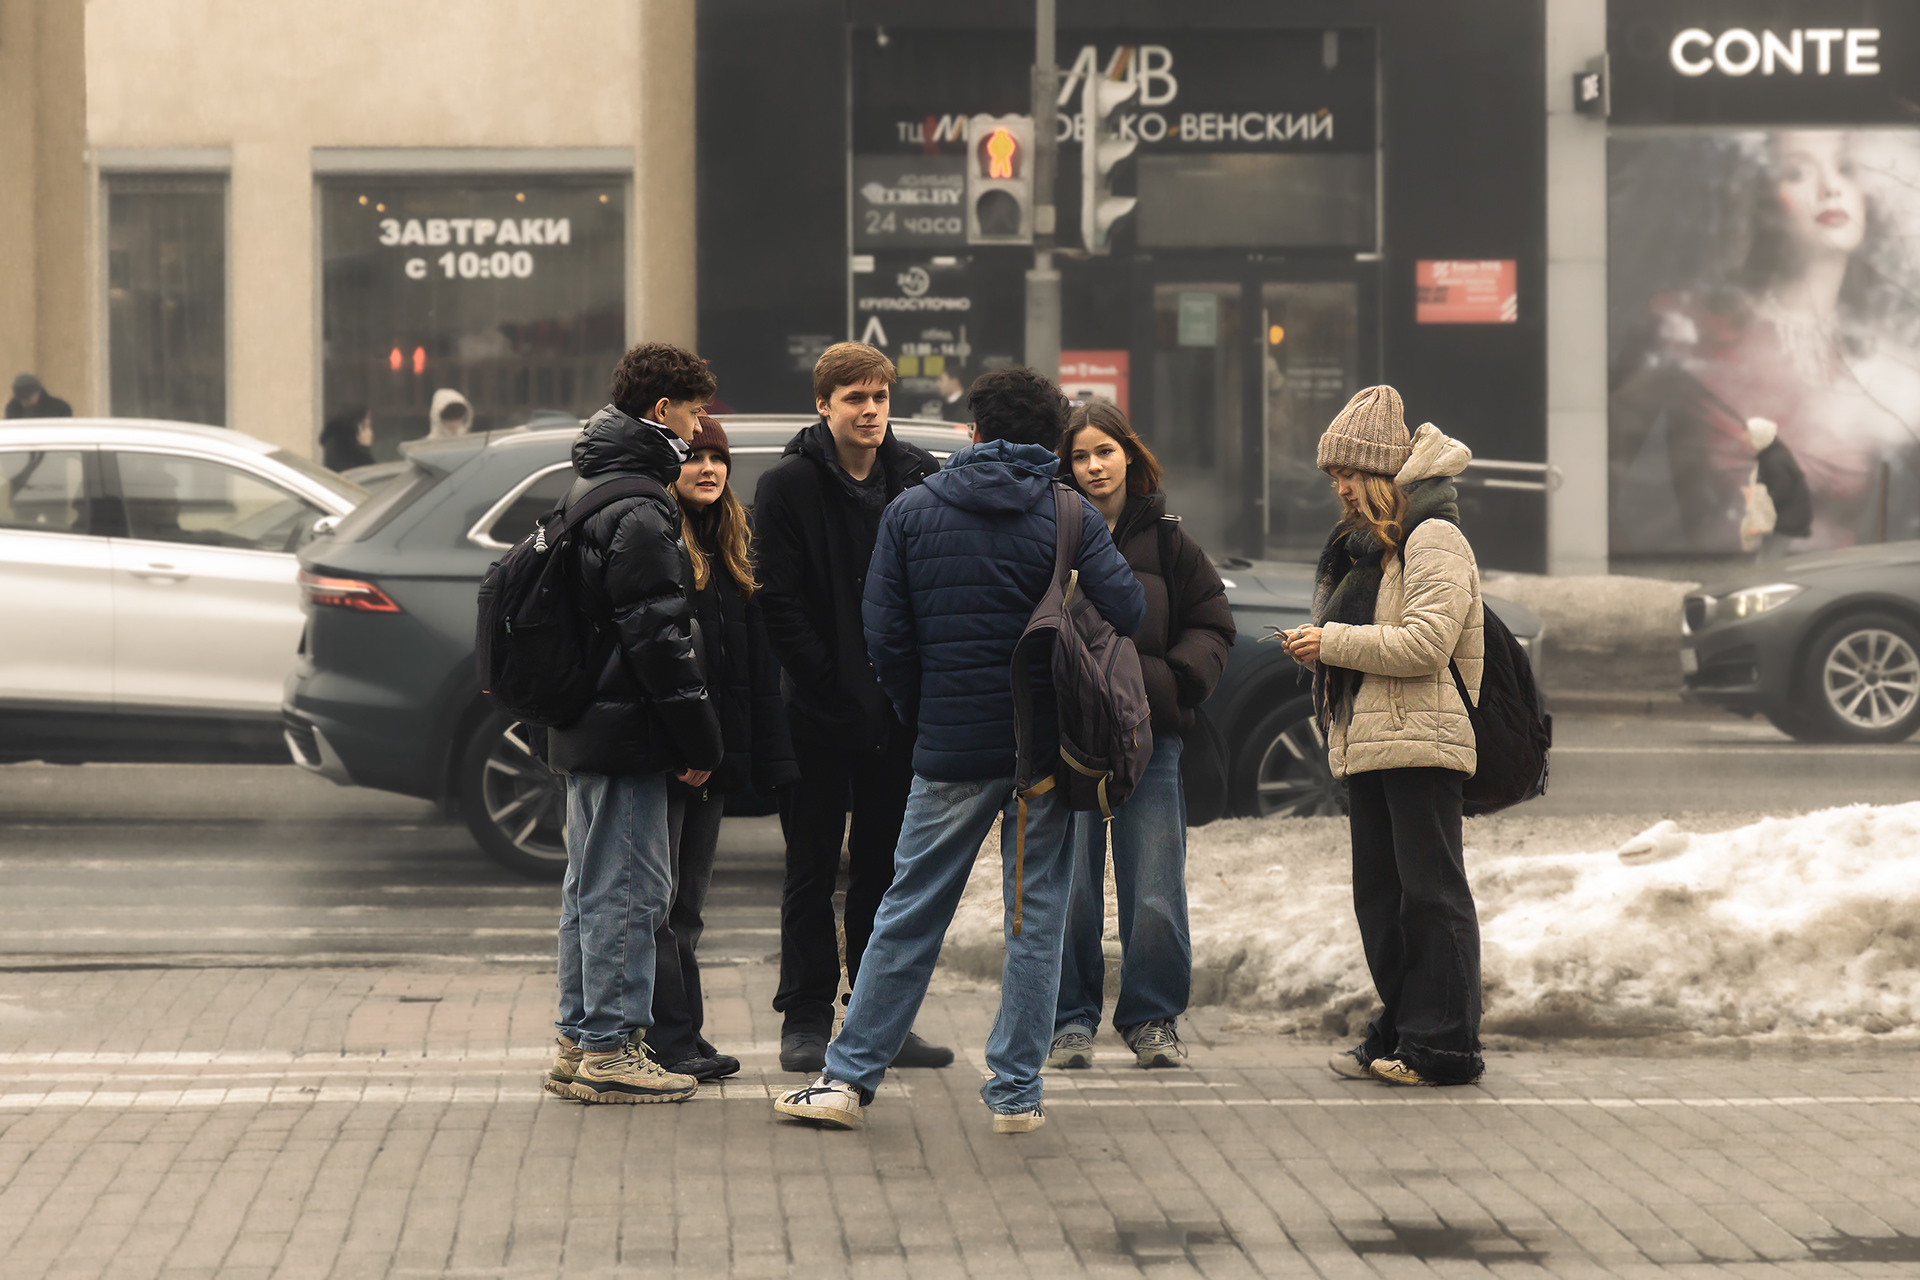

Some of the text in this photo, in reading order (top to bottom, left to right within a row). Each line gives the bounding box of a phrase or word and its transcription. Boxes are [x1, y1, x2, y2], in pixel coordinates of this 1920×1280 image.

[1670, 28, 1881, 76] CONTE
[379, 218, 571, 246] ЗАВТРАКИ
[865, 209, 962, 235] 24 часа
[405, 251, 534, 280] с 10:00
